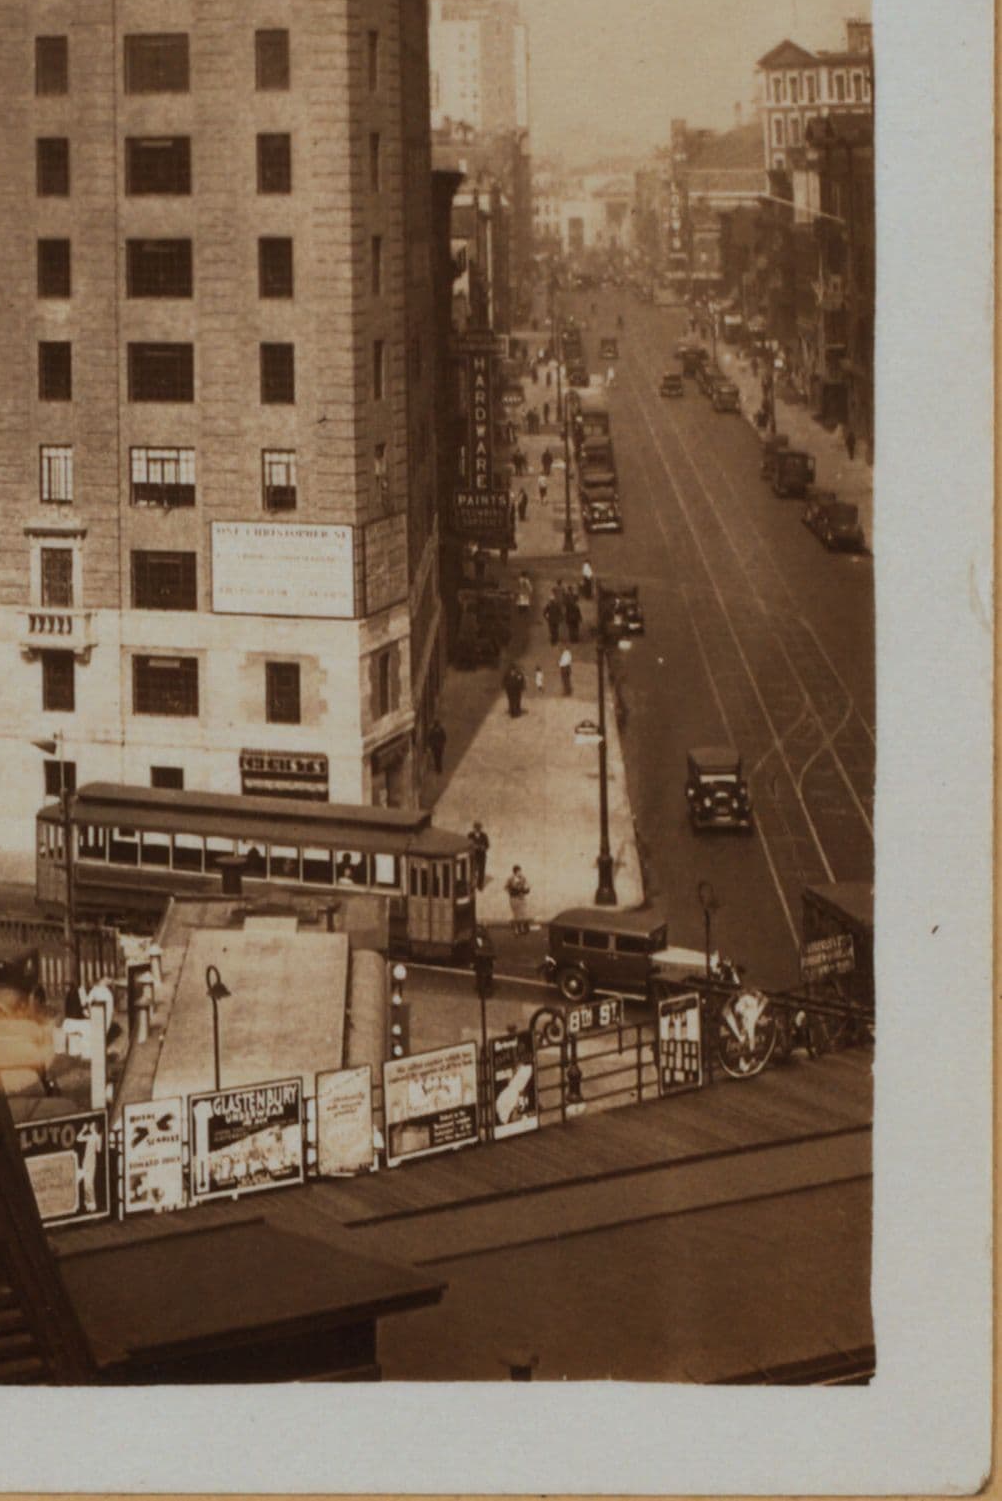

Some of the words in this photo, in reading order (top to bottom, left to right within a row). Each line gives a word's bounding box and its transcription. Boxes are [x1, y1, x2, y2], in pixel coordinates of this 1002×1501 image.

[473, 356, 487, 488] HARDWARE
[457, 493, 507, 506] PAINTS
[212, 1085, 297, 1116] GLASTENBURY
[19, 1123, 76, 1150] LUTO
